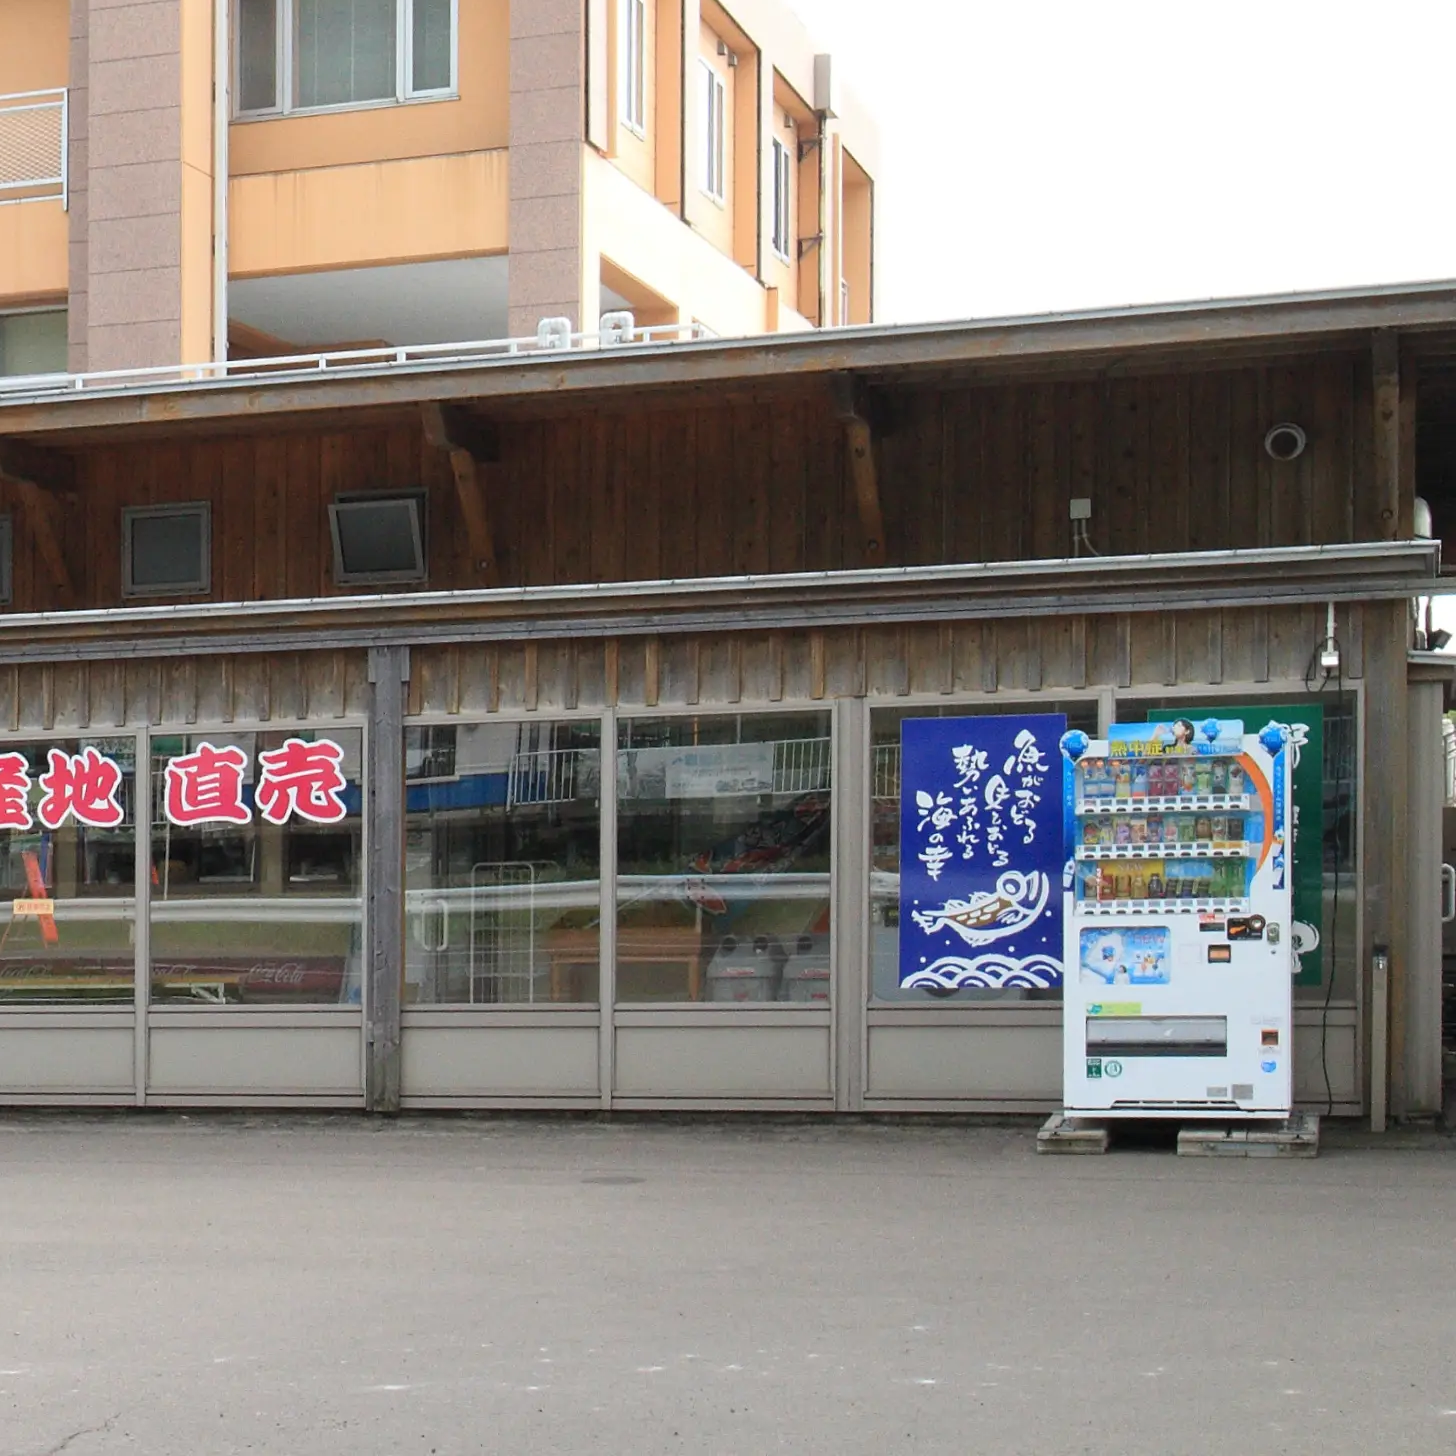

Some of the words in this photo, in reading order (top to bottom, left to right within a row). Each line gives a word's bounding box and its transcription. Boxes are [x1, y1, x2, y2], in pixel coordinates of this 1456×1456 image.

[164, 737, 348, 827] 直売
[1003, 729, 1049, 844] 魚がおどる
[916, 790, 958, 881] 海の幸
